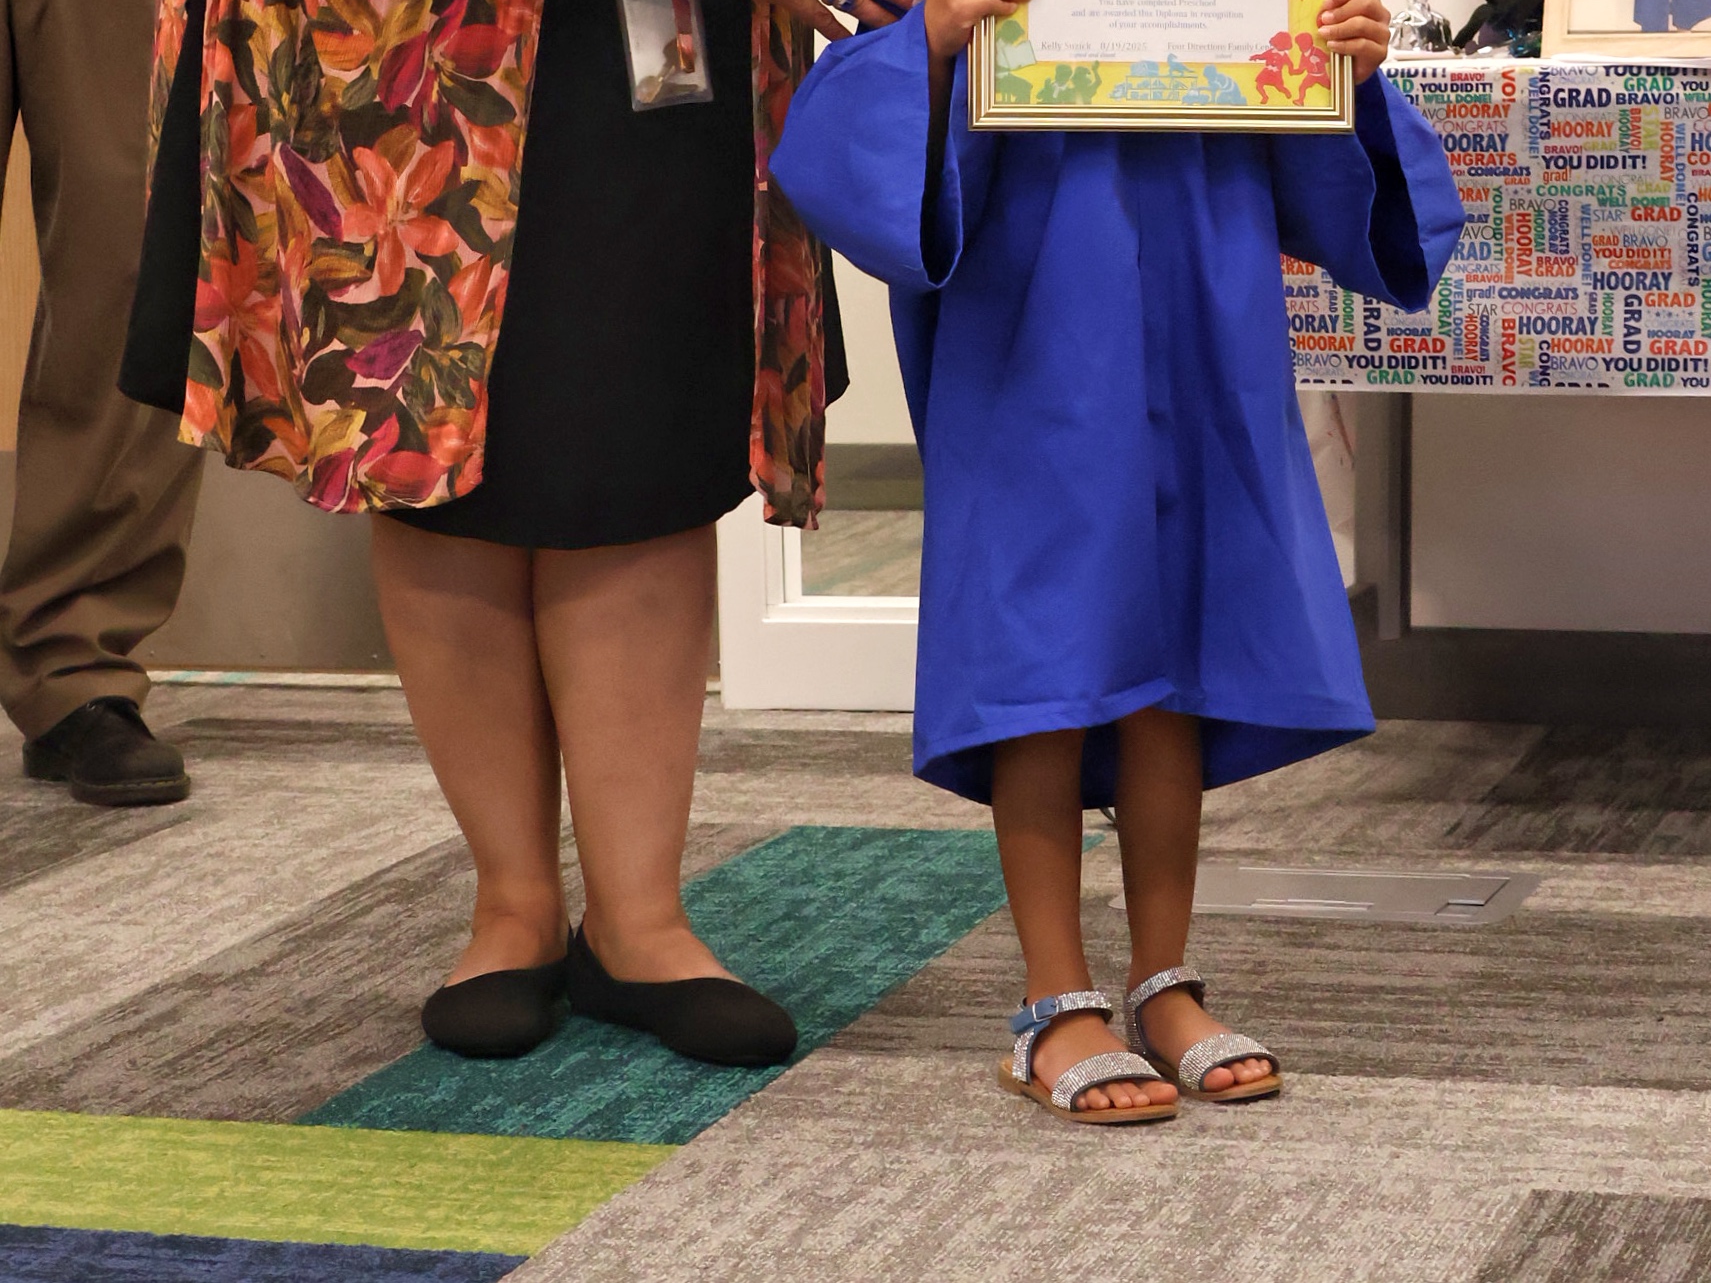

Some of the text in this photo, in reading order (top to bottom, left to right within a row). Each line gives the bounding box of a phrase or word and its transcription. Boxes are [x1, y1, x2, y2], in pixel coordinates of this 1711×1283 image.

[1155, 9, 1188, 21] Diploma
[1228, 43, 1254, 54] Family
[1450, 72, 1485, 82] BRAVO!
[1624, 77, 1674, 92] GRAD
[1419, 82, 1448, 93] YOU
[1450, 83, 1474, 93] DID
[1527, 76, 1540, 111] WELL
[1680, 81, 1710, 92] YOU
[1423, 93, 1453, 104] WELL
[1455, 93, 1492, 104] DONE!
[1539, 66, 1551, 141] NGRATS
[1553, 87, 1612, 108] GRAD
[1615, 92, 1680, 105] BRAVO!
[1446, 104, 1511, 118] HOORAY
[1664, 106, 1709, 119] BRAVO
[1432, 120, 1508, 134] CONGRATS
[1551, 121, 1614, 138] HOORAY
[1618, 109, 1631, 153] HOORAY
[1630, 107, 1642, 151] BRAVO!
[1441, 133, 1510, 153] OORAY
[1527, 114, 1540, 159] DONE!
[1543, 145, 1582, 155] BRAVO!
[1583, 141, 1617, 151] GRAD
[1660, 120, 1675, 183] HOORAY
[1447, 152, 1517, 166] NGRATS
[1541, 154, 1647, 170] YOU DID IT!
[1675, 122, 1687, 207] WELL DONE!
[1467, 166, 1531, 177] CONGRATS
[1542, 168, 1572, 185] grad!
[1504, 177, 1531, 185] GRAD
[1536, 184, 1627, 197] CONGRATS
[1492, 186, 1503, 214] YOU
[1509, 198, 1557, 212] BRAVO
[1597, 196, 1671, 208] WELL DONE!
[1592, 208, 1623, 222] STAR
[1631, 206, 1682, 222] GRAD
[1462, 225, 1494, 240] AVO
[1533, 209, 1545, 254] HOORAY
[1559, 199, 1570, 255] CONGRATS
[1516, 211, 1533, 277] HOORAY
[1581, 203, 1593, 286] WELL DONE!
[1592, 235, 1620, 247] GRAD
[1622, 235, 1668, 248] BRAVO
[1686, 192, 1700, 287] CONGRATS
[1453, 241, 1491, 261] RAD
[1593, 248, 1672, 259] YOU DID IT!
[1536, 256, 1579, 265] BRAVO!
[1608, 259, 1672, 270] CONGRATS
[1447, 263, 1500, 274] ONGRATS
[1535, 264, 1576, 277] GRAD
[1465, 274, 1503, 283] BRAVO!
[1592, 271, 1672, 291] HOORAY
[1328, 289, 1339, 313] GRAD
[1466, 285, 1495, 302] grad!
[1498, 287, 1579, 300] CONGRATS
[1644, 292, 1696, 307] GRAD
[1438, 276, 1452, 337] HOORAY
[1468, 302, 1498, 316] STAR
[1501, 301, 1578, 315] CONGRATS
[1453, 278, 1464, 361] WELL DONE!
[1602, 292, 1614, 337] HOORAY
[1289, 313, 1340, 334] ORAY
[1518, 315, 1599, 336] HOORAY
[1623, 293, 1642, 354] GRAD
[1386, 327, 1433, 337] HOORAY
[1464, 313, 1478, 362] HOORAY
[1647, 329, 1696, 339] HOORAY
[1296, 335, 1356, 352] HOORAY
[1389, 337, 1446, 354] GRAD
[1550, 338, 1614, 354] HOORAY
[1649, 340, 1708, 356] GRAD
[1296, 353, 1342, 368] BRAVO
[1344, 354, 1447, 370] YOU DID IT!
[1538, 340, 1551, 387] CONG
[1550, 356, 1599, 371] BRAVO
[1601, 357, 1709, 372] YOU DID IT!
[1366, 369, 1416, 385] GRAD
[1451, 365, 1486, 375] BRAVO!
[1420, 375, 1493, 386] YOU DID IT!
[1623, 372, 1675, 388] GRAD
[1680, 377, 1710, 388] YOU
